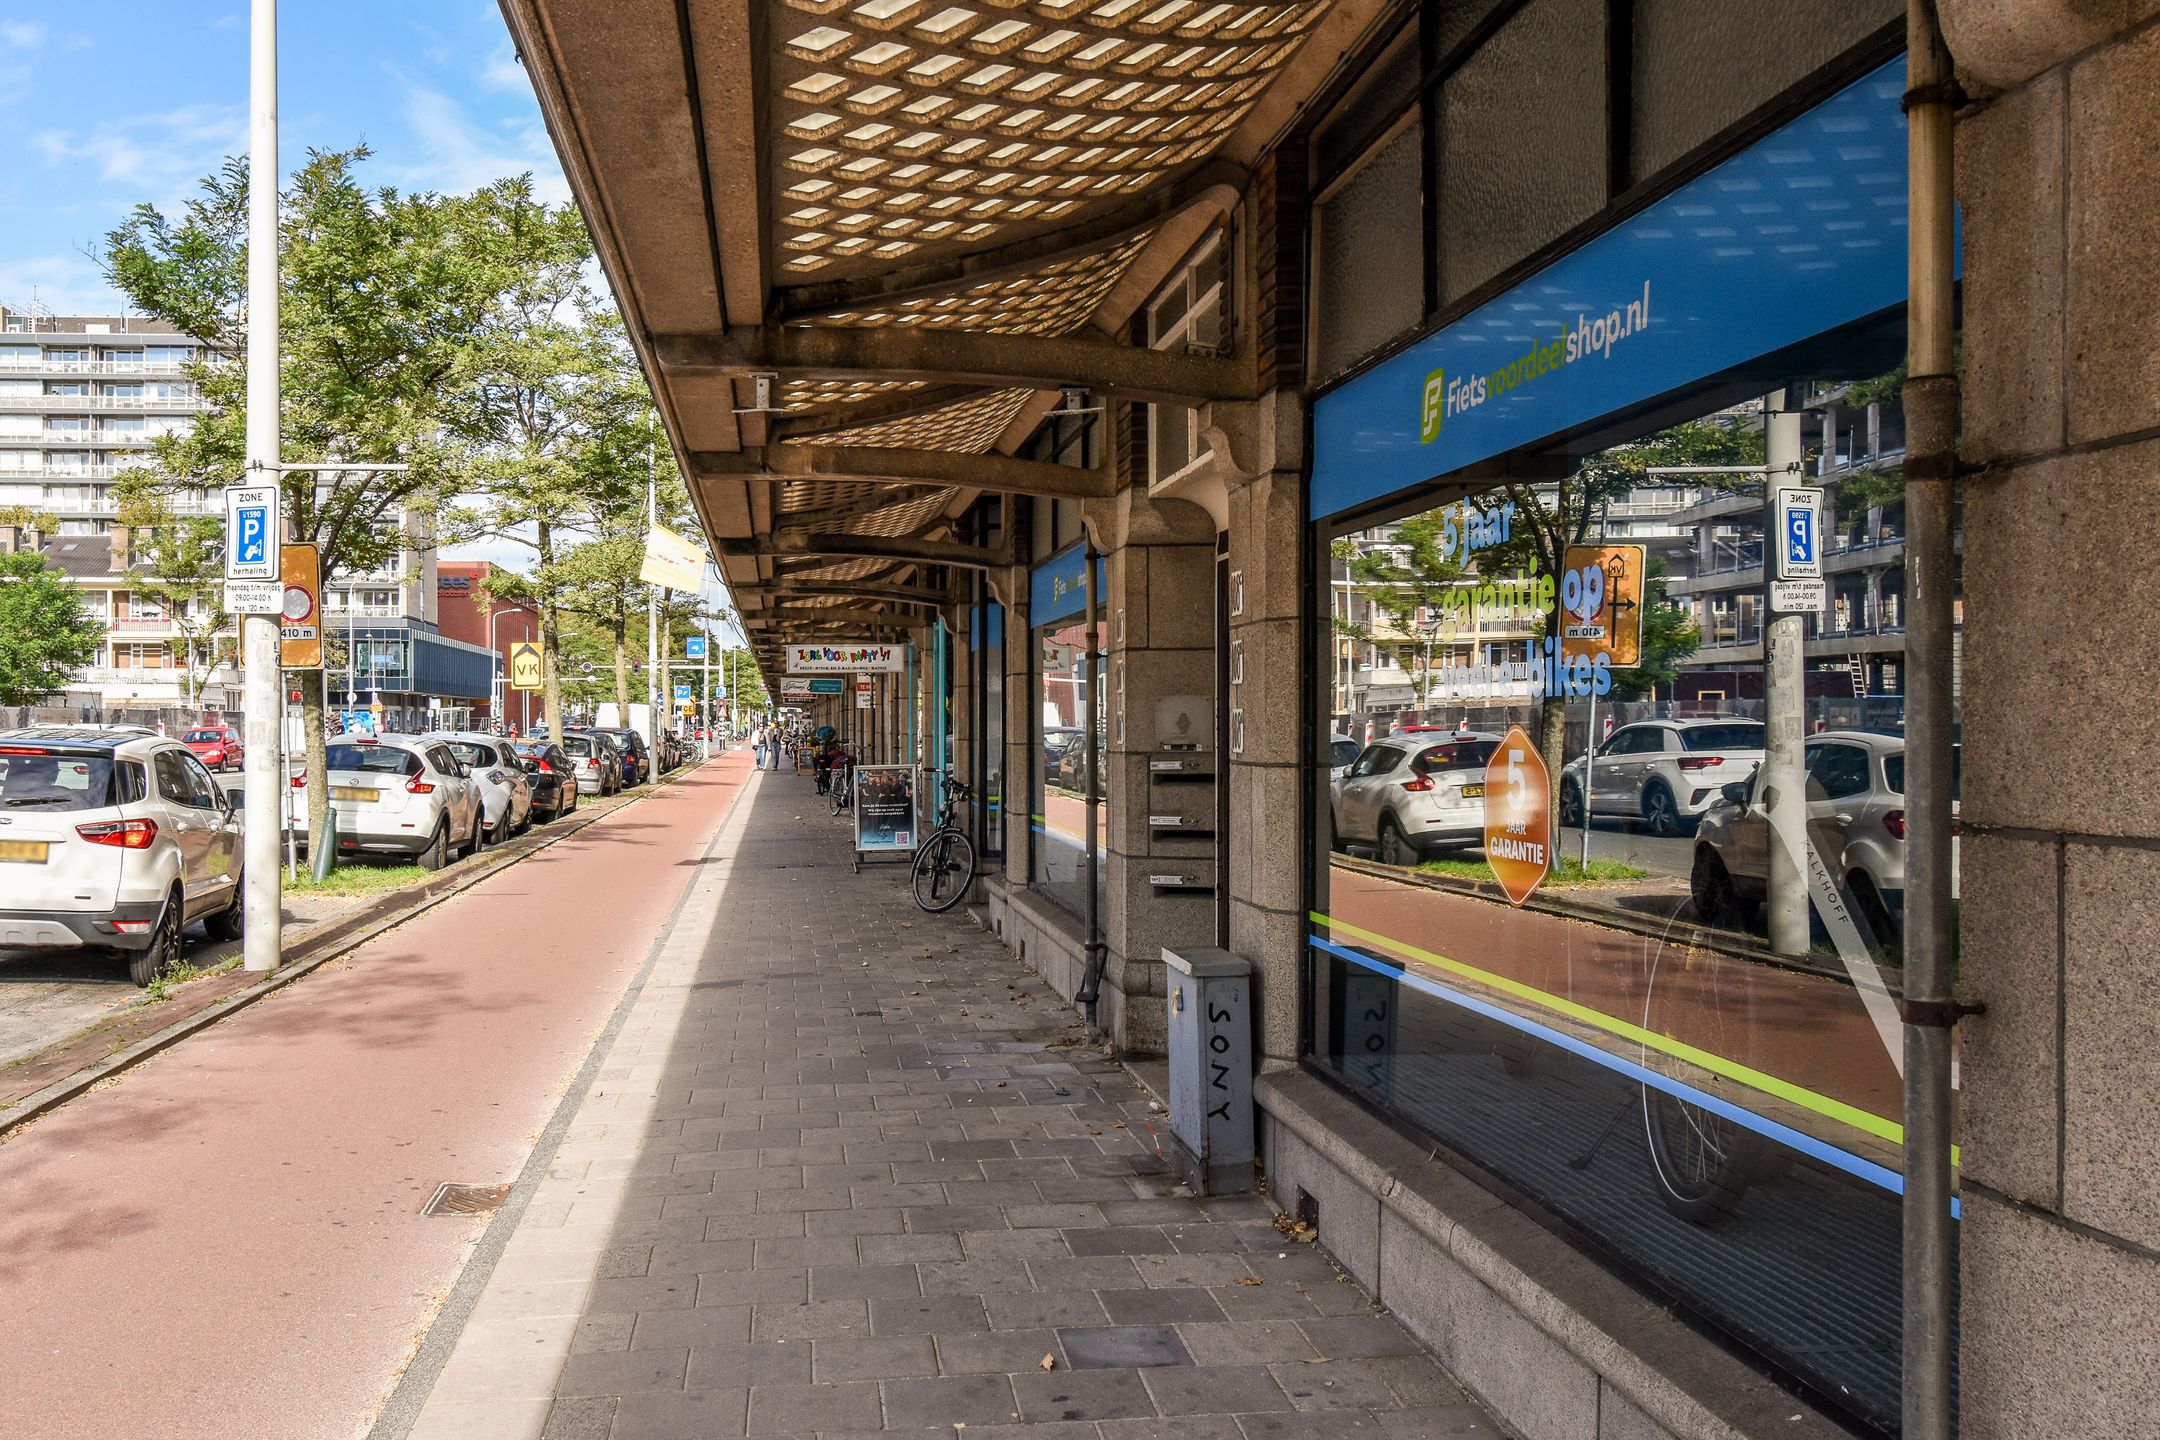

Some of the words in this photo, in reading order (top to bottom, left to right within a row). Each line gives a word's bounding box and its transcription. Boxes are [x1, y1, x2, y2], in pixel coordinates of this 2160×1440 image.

[1448, 280, 1650, 418] Fietsvoordeelshop.nl
[239, 493, 263, 502] ZONE
[244, 519, 259, 544] P
[1443, 505, 1458, 556] 5
[1459, 498, 1516, 568] jaar
[263, 584, 280, 593] vrijdag
[1442, 556, 1555, 644] garantie
[1564, 562, 1603, 625] op
[281, 628, 298, 638] 410
[798, 648, 822, 662] ZORG
[823, 647, 848, 662] VOOR
[1443, 644, 1492, 699] veel
[1498, 636, 1612, 698] e-bikes
[516, 664, 538, 676] VK
[1508, 749, 1526, 810] 5
[1506, 818, 1526, 835] JAAR
[1490, 836, 1544, 865] GARANTIE
[1208, 1002, 1231, 1120] SONY
